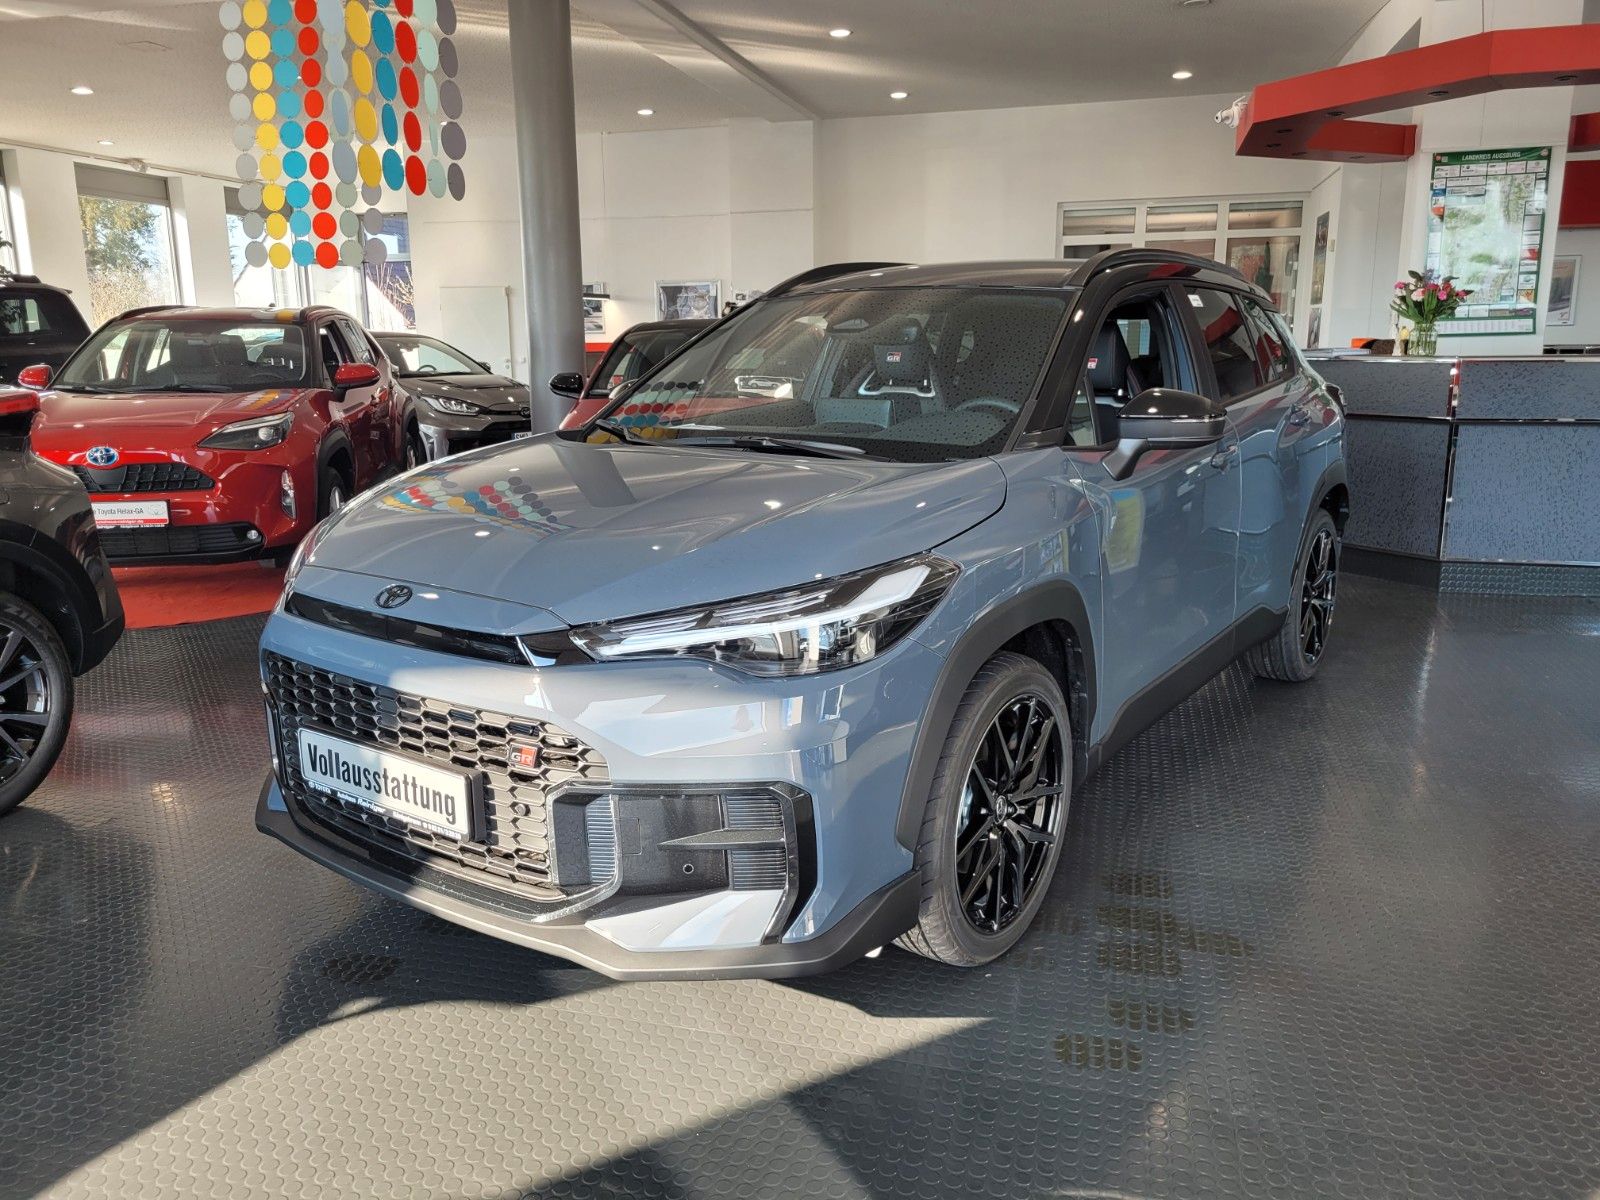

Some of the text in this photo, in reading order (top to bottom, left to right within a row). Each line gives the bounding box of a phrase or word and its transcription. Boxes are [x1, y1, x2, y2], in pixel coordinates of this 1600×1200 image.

[98, 508, 116, 516] Toyota
[511, 752, 534, 765] GR
[307, 743, 456, 825] Vollausstattung
[357, 798, 386, 813] Reiniger
